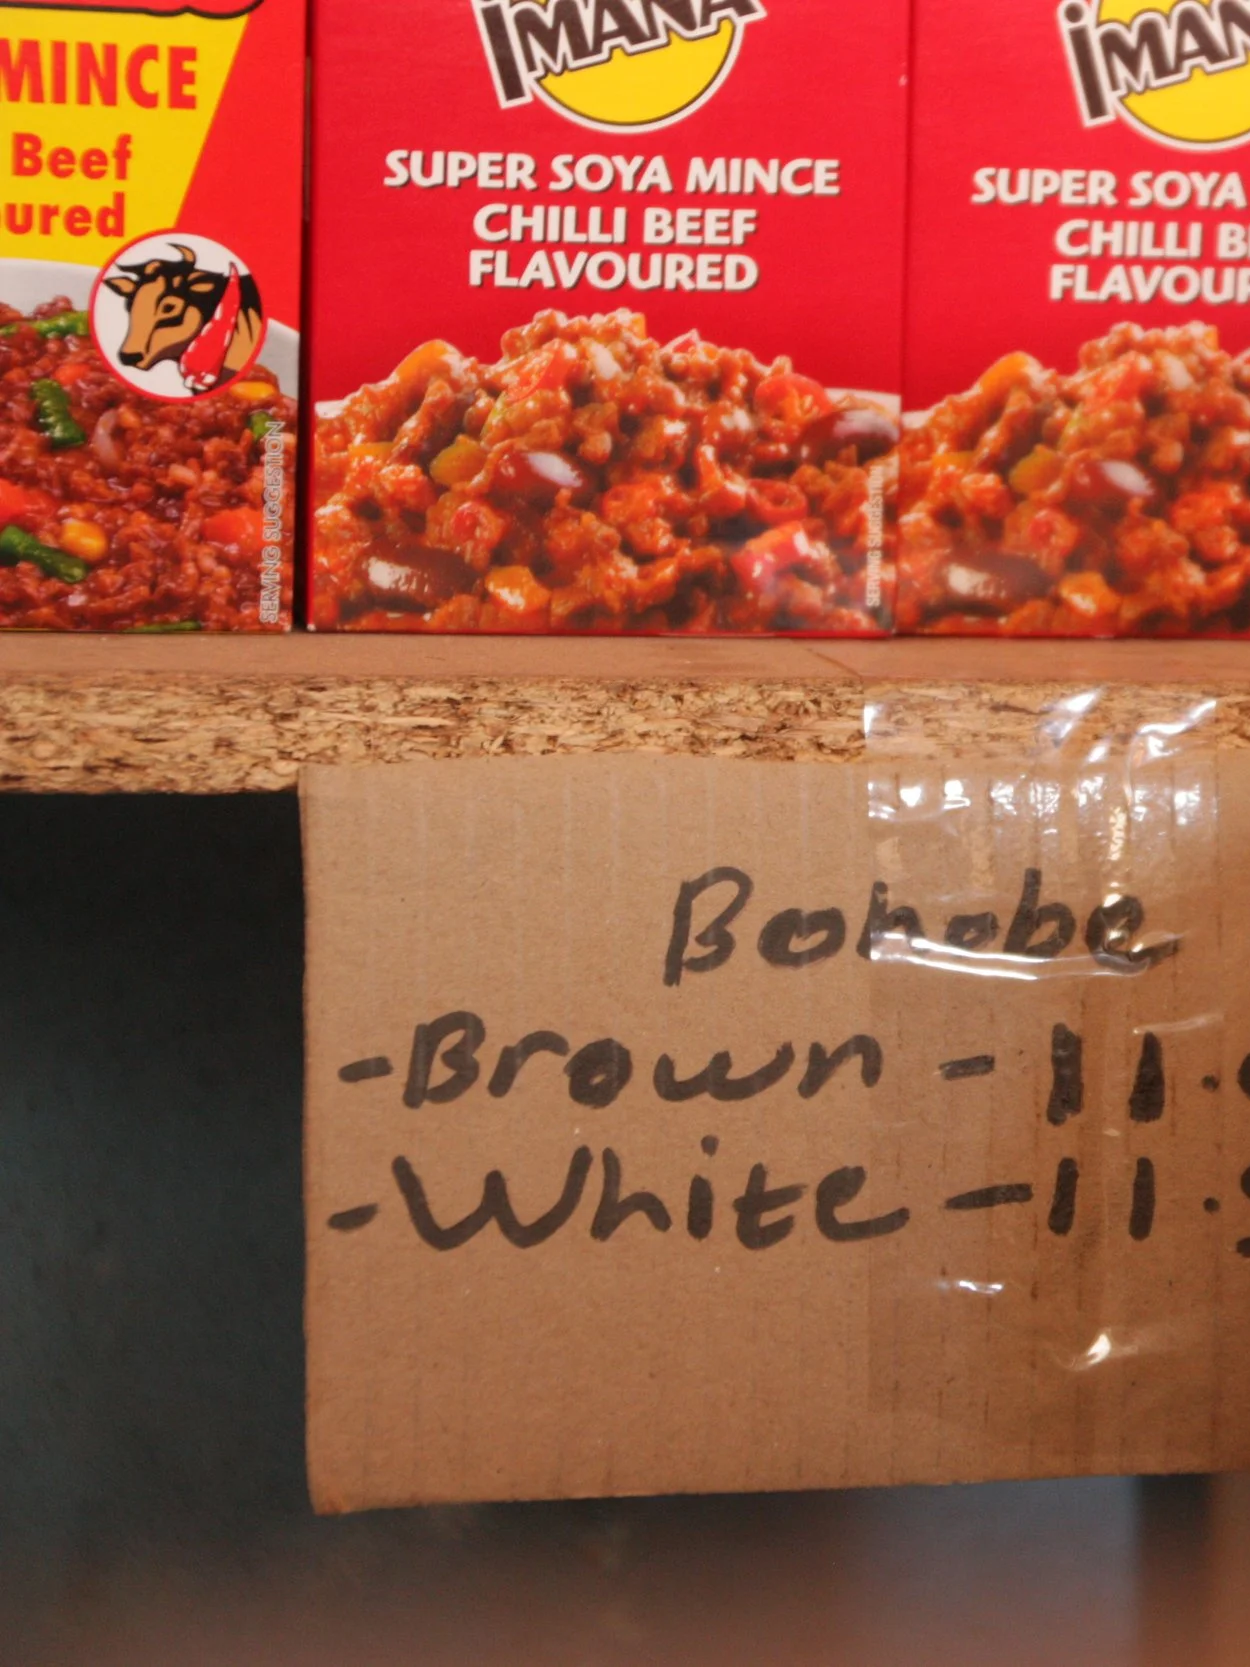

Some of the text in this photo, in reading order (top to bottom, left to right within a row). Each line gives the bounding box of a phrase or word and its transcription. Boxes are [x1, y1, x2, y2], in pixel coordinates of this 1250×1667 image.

[0, 38, 198, 110] MINCE
[11, 131, 133, 181] Beef
[384, 150, 840, 195] SUPER SOYA MINCE
[972, 167, 1117, 205] SUPER
[1128, 171, 1246, 209] SOYA
[473, 204, 756, 245] CHILLI BEEF
[1055, 219, 1201, 258] CHILLI
[469, 250, 758, 291] FLAVOURED
[259, 421, 286, 625] SERVING SUGGESTION
[865, 550, 883, 607] SERVING
